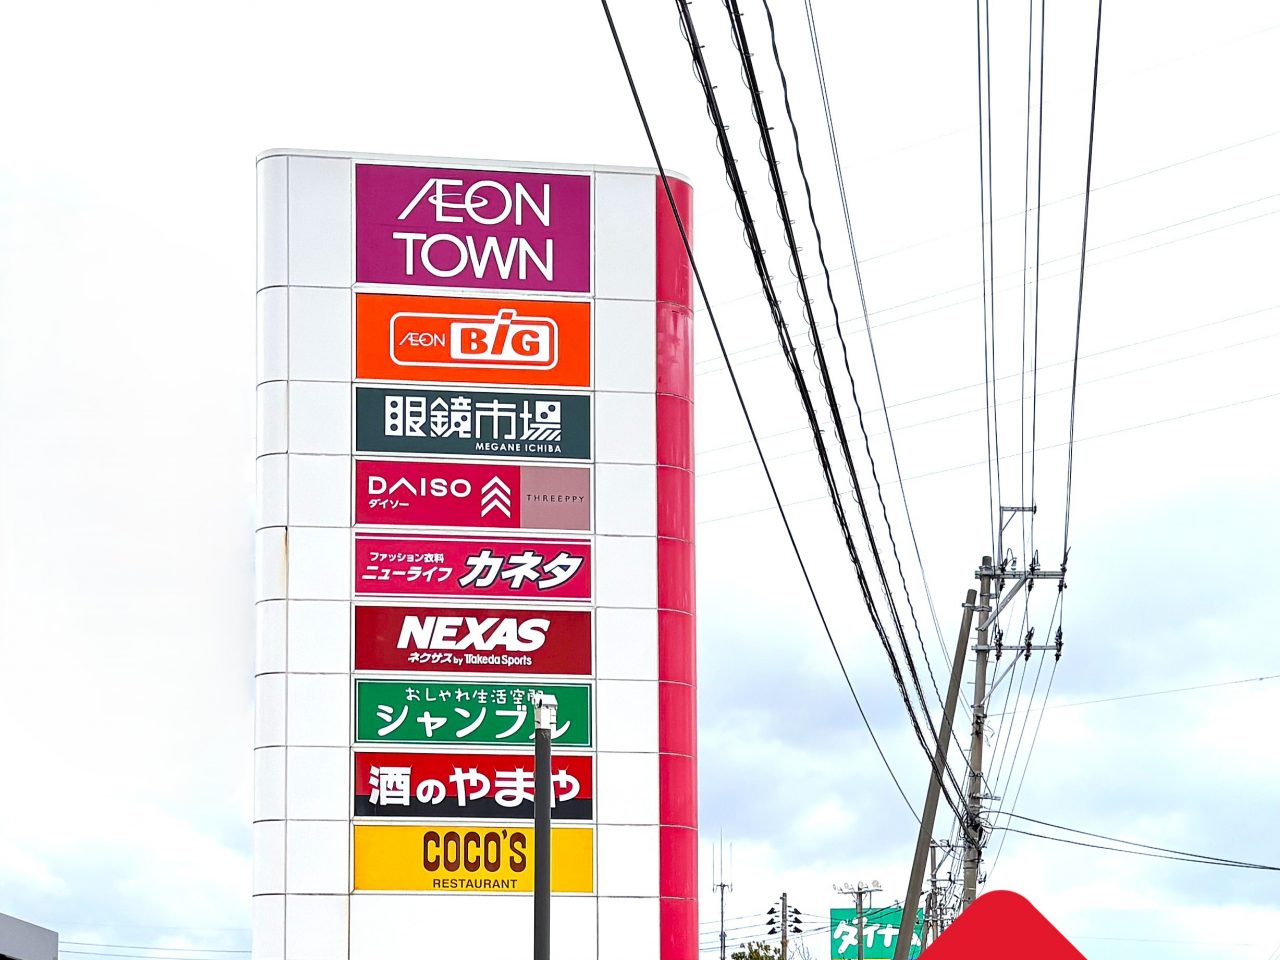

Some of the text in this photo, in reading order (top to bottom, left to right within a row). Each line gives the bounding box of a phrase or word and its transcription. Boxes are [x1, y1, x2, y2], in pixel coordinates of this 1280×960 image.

[392, 231, 553, 281] TOWN
[384, 395, 561, 441] 眼鏡市場
[475, 442, 562, 453] MEGANE ICHIBA
[368, 475, 472, 497] DAISO
[368, 499, 409, 510] ダイソー
[526, 494, 585, 503] THREEPPY
[369, 551, 444, 564] ファッション衣料
[362, 565, 454, 583] ニューライフ
[458, 550, 585, 589] カネタ
[397, 615, 550, 652] NEXAS
[407, 652, 533, 667] ネクサス by Takeda Sports
[368, 764, 581, 809] 酒のやまや
[423, 830, 527, 873] COCO'S
[432, 879, 518, 889] RESTAURANT
[833, 918, 921, 954] ダイナ
